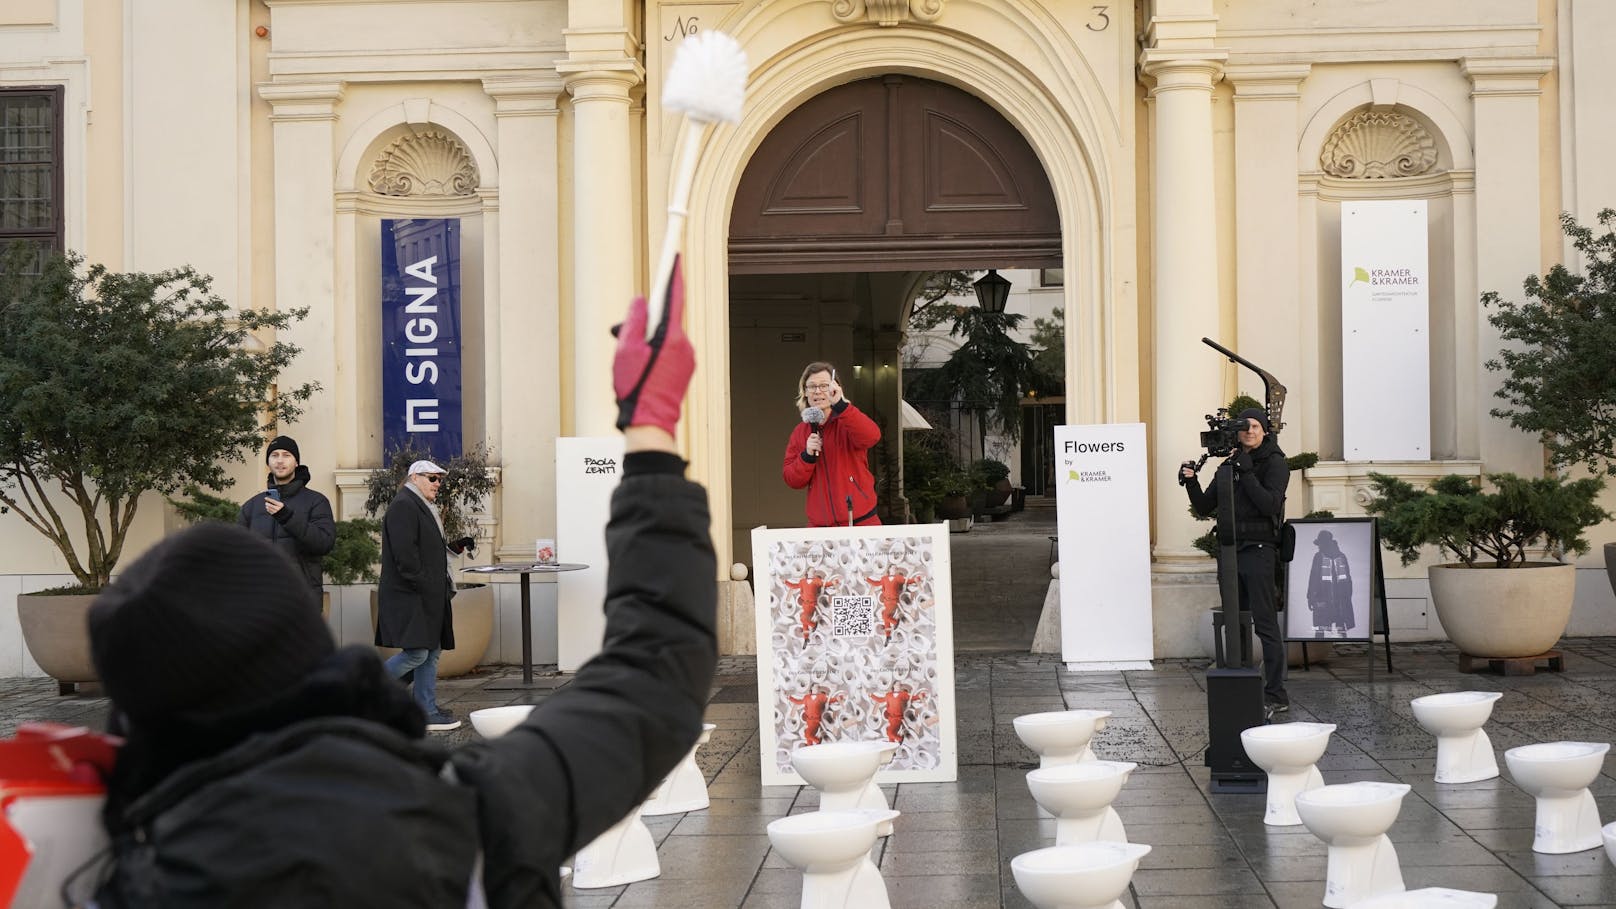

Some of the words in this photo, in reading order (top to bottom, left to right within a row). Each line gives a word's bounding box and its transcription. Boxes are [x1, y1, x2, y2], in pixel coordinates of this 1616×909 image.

[1086, 6, 1109, 31] 3
[1371, 269, 1411, 277] KRAMER
[405, 255, 438, 385] SIGNA
[1064, 440, 1125, 453] Flowers
[584, 457, 616, 465] PAOLA
[585, 465, 616, 474] LENTI
